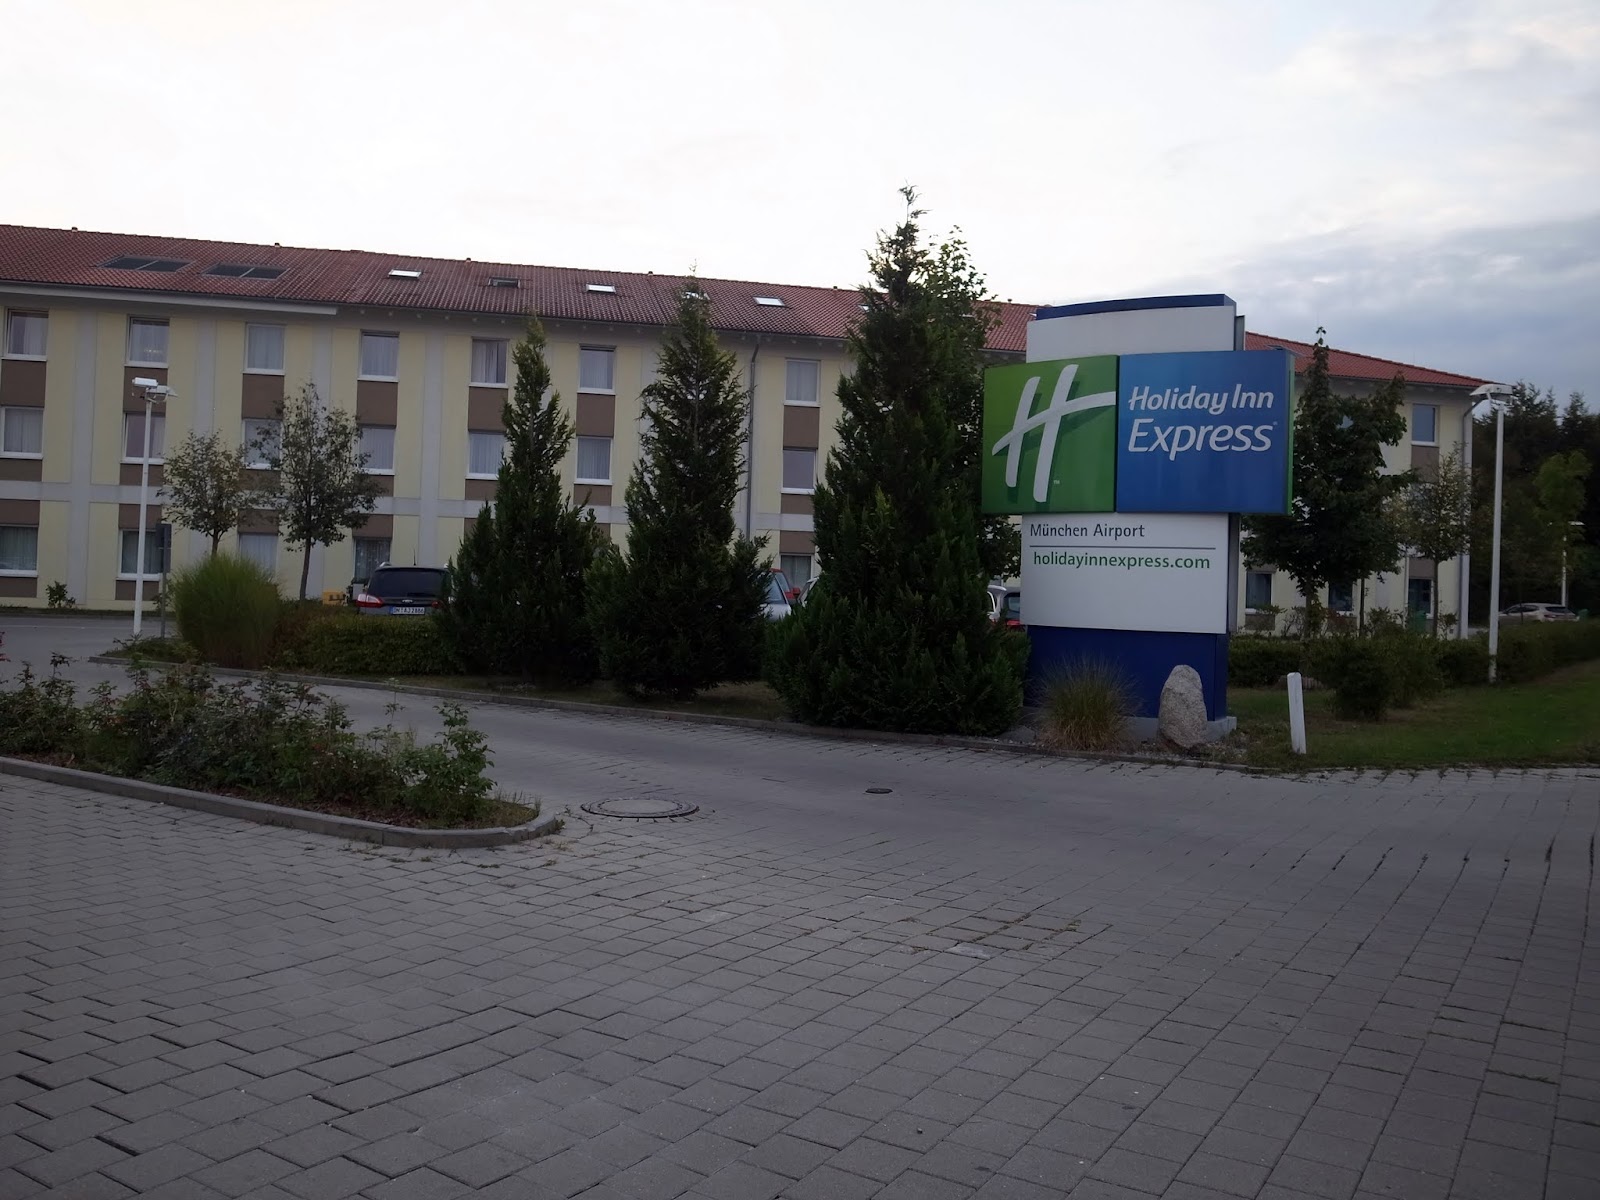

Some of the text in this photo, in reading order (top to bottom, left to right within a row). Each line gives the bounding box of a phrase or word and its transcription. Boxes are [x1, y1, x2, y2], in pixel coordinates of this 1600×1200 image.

[1128, 383, 1274, 415] Holiday Inn
[1128, 418, 1274, 461] Express
[1030, 523, 1145, 541] München Airport
[1033, 551, 1210, 571] holidayinnexpress.com
